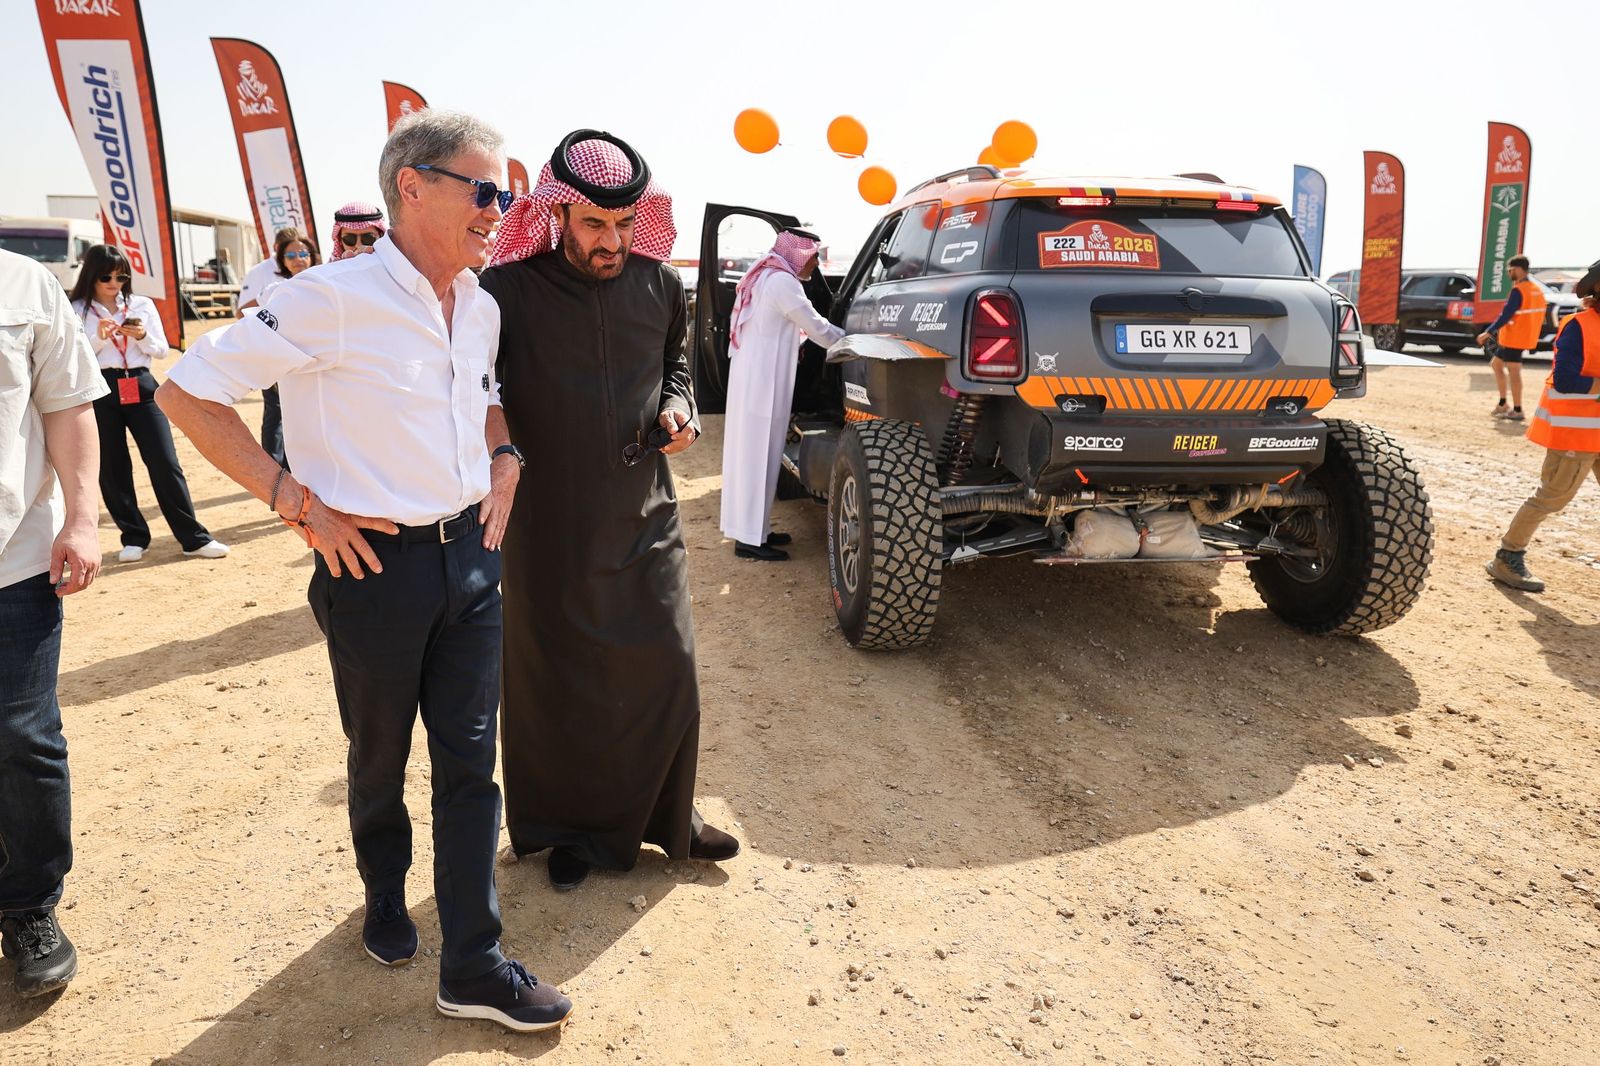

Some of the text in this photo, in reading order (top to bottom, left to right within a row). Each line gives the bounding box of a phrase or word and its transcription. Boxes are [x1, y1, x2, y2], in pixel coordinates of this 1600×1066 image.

[238, 95, 279, 117] DAKAR
[83, 64, 146, 276] BFGoodrich
[941, 211, 977, 229] FASTER
[1296, 192, 1308, 238] UTURE
[1053, 238, 1076, 249] 222
[1087, 240, 1112, 251] DAKAR
[1113, 236, 1154, 253] 2026
[1061, 251, 1140, 263] SAUDI ARABIA
[1491, 217, 1510, 293] SAUDI ARABIA
[910, 302, 944, 323] REIGER
[1140, 330, 1239, 349] GG XR 621
[1064, 436, 1124, 451] sparco
[1173, 435, 1218, 450] REIGER
[1248, 437, 1319, 449] BFGoodrich
